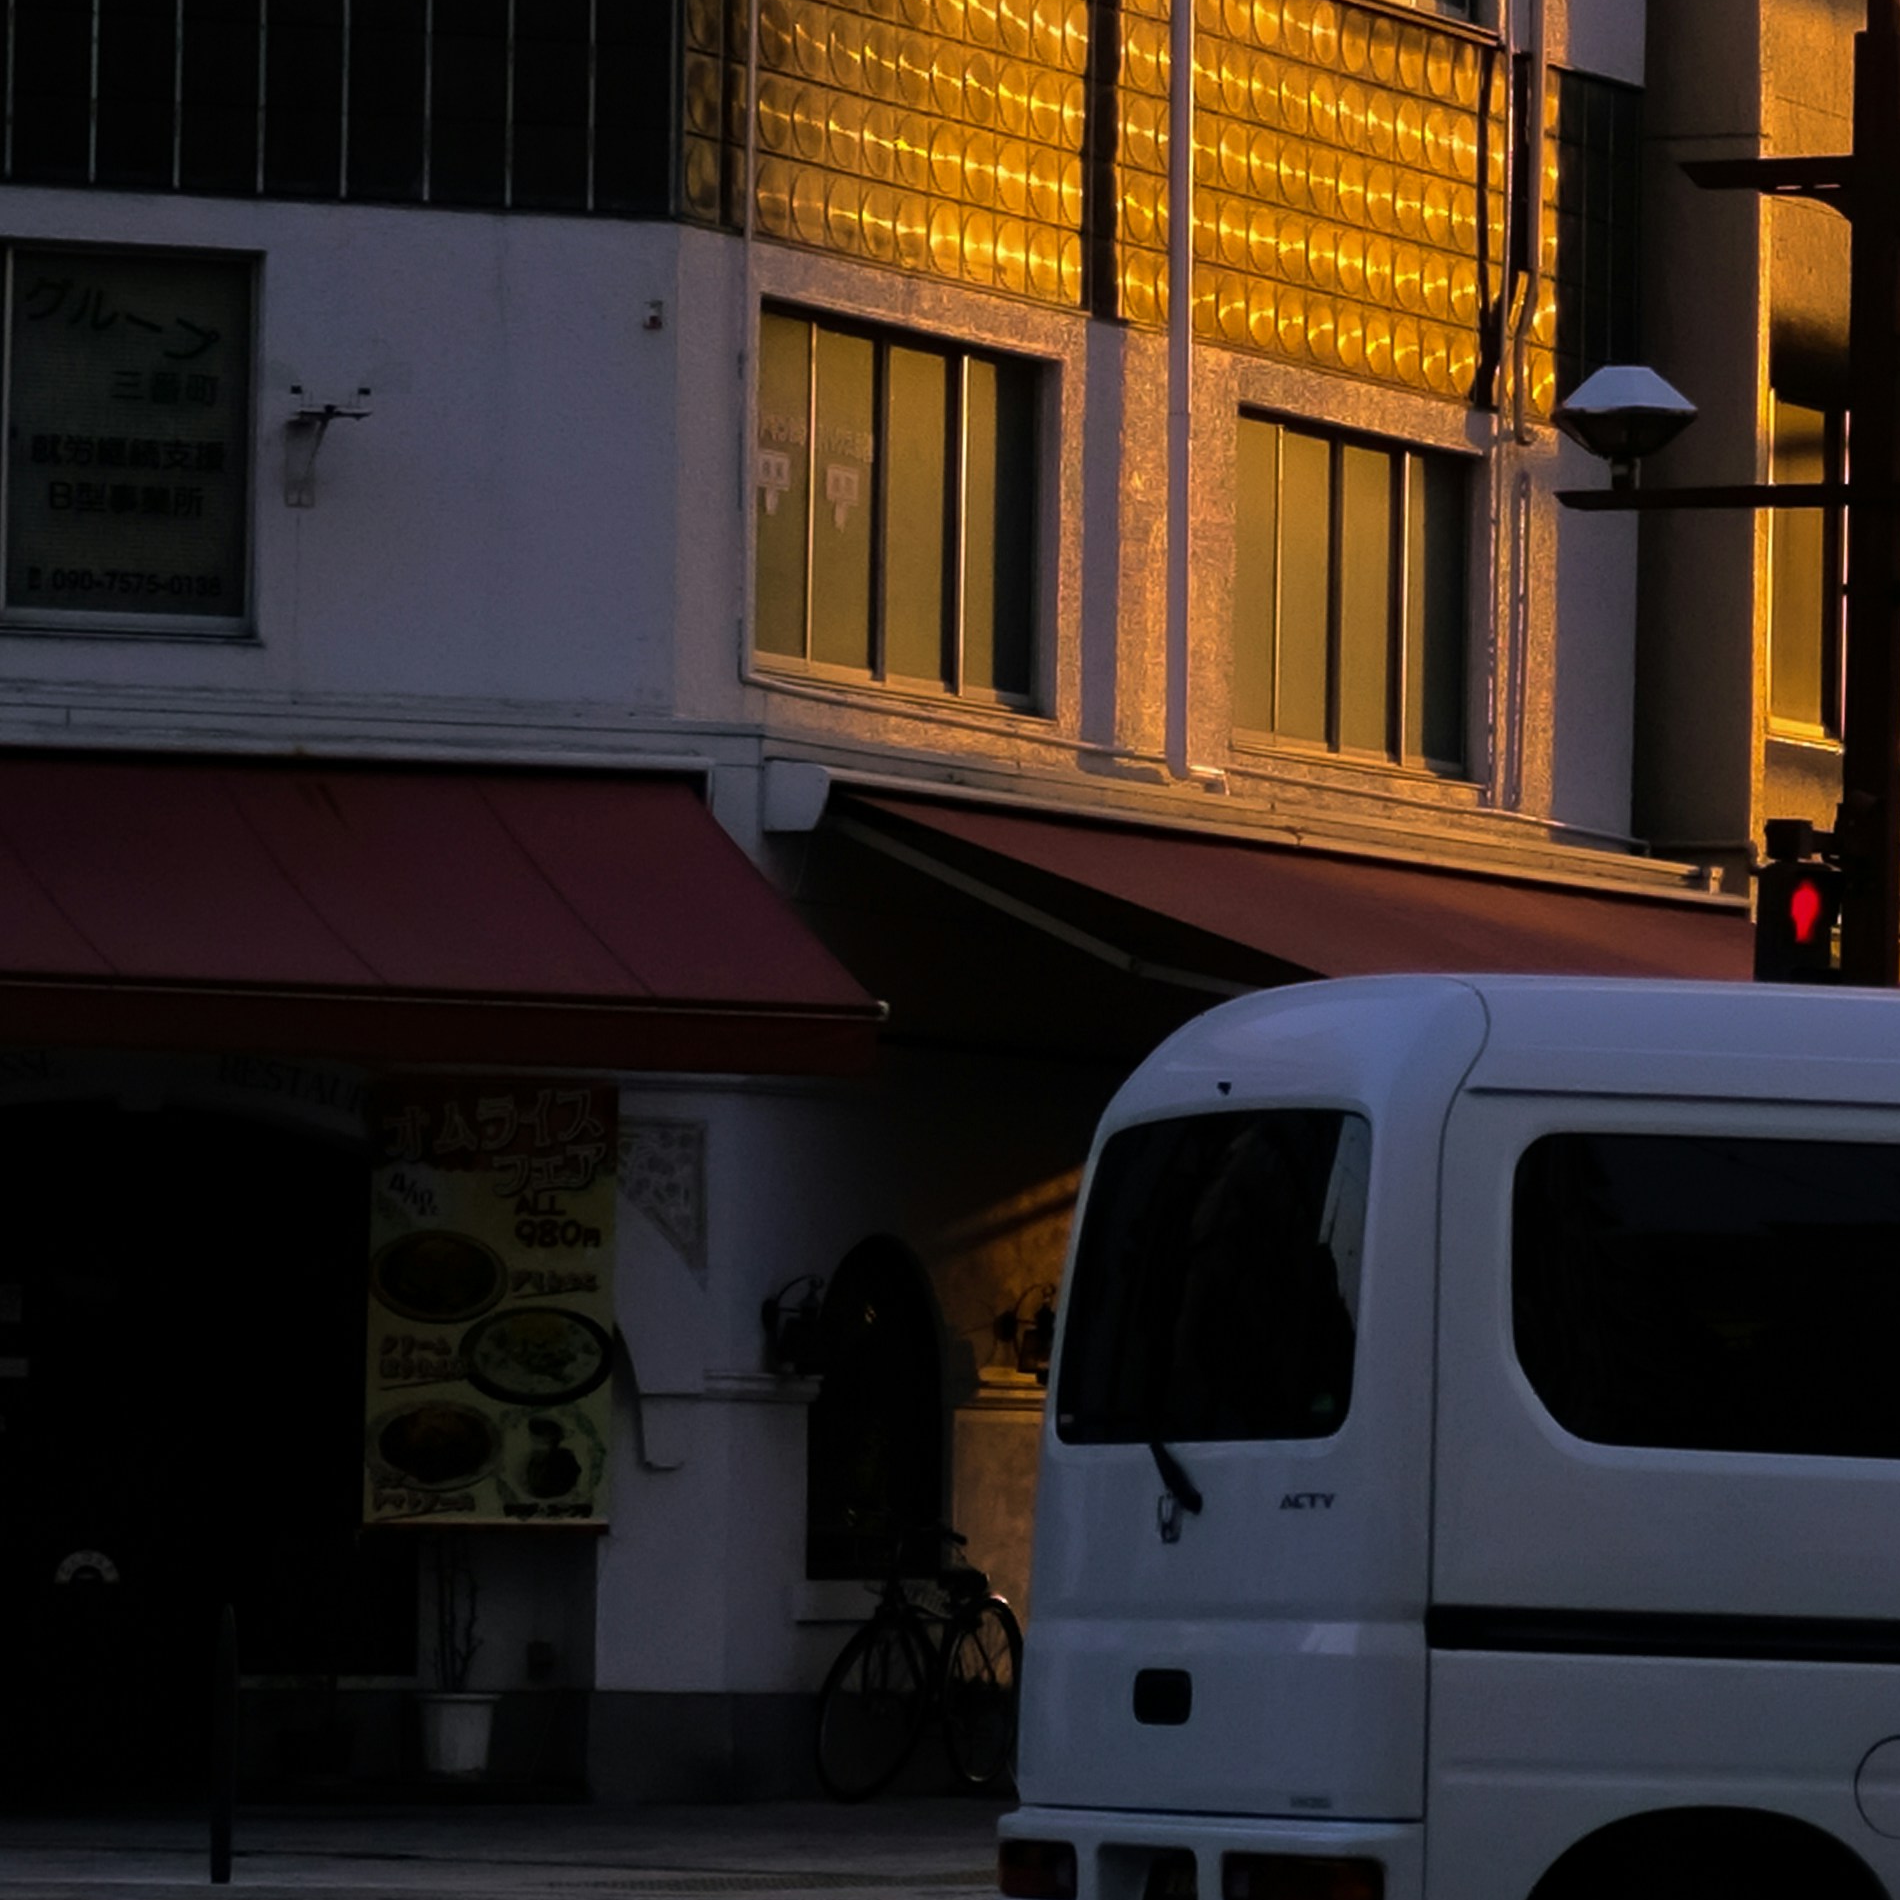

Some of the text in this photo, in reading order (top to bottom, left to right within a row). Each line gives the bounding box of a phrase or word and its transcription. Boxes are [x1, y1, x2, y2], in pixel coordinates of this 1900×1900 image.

[25, 277, 221, 359] グループ
[112, 371, 219, 408] 三番町
[49, 481, 204, 517] B型事業所
[383, 1088, 606, 1164] オムライス
[491, 1142, 608, 1198] フェア
[514, 1195, 566, 1216] ALL
[514, 1219, 602, 1248] 980円
[1279, 1493, 1335, 1510] ACTY
